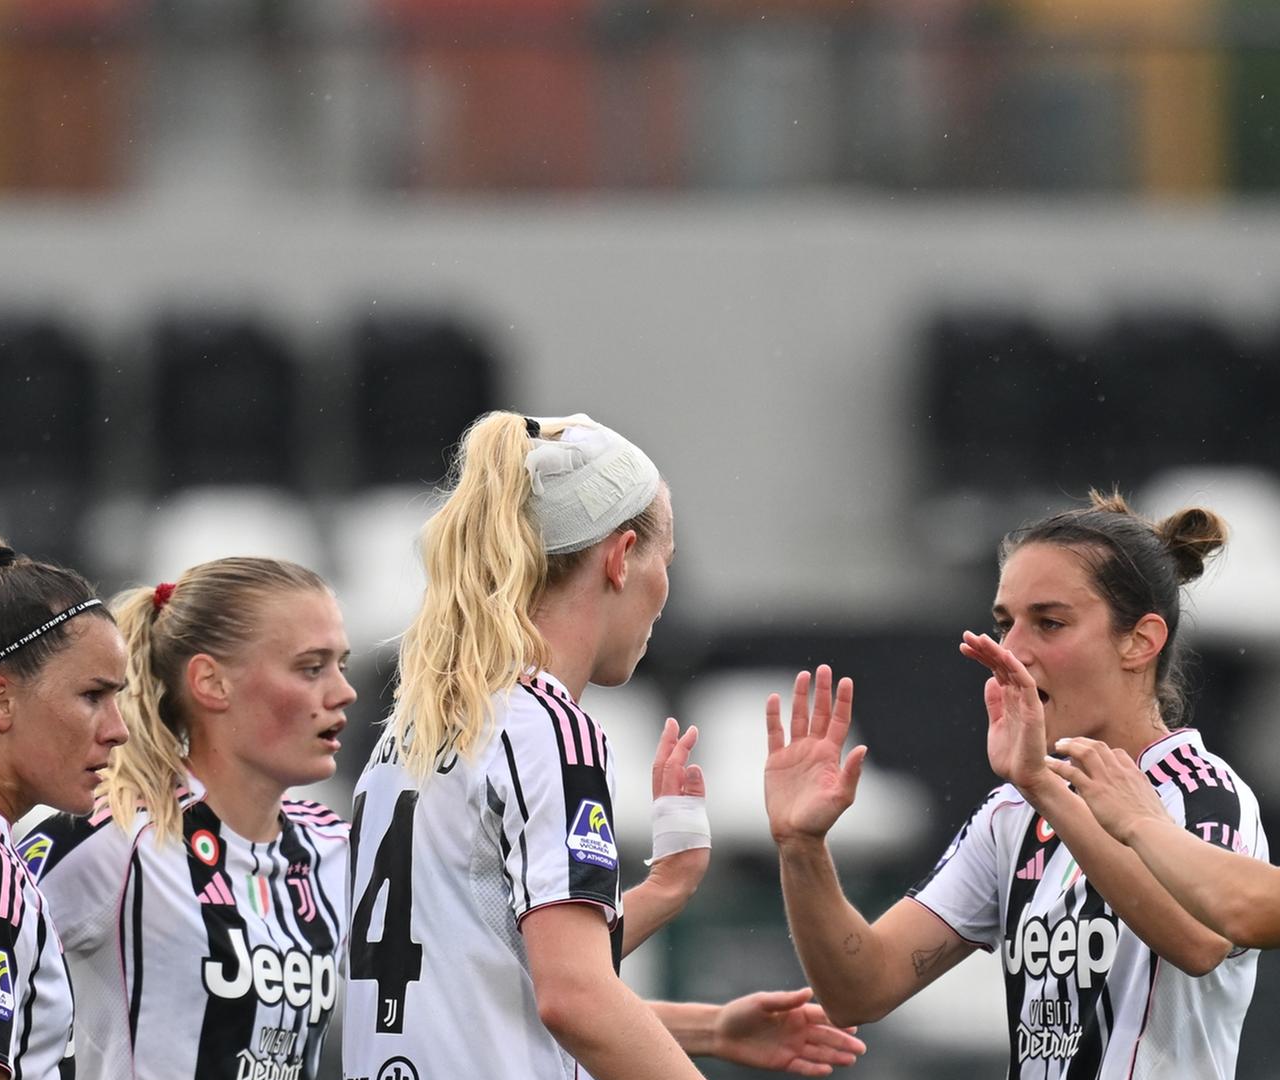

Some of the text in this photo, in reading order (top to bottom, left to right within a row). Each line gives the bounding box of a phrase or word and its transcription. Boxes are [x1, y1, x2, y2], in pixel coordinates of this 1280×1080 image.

[5, 641, 20, 653] THE
[19, 628, 43, 645] THREE
[40, 612, 68, 632] STRIPES
[586, 853, 613, 866] ATHORA
[1004, 902, 1118, 989] Jeep
[204, 927, 337, 1024] Jeep
[1029, 999, 1072, 1026] VISIT
[259, 1026, 298, 1057] VISIT
[1016, 1021, 1083, 1065] Detroit
